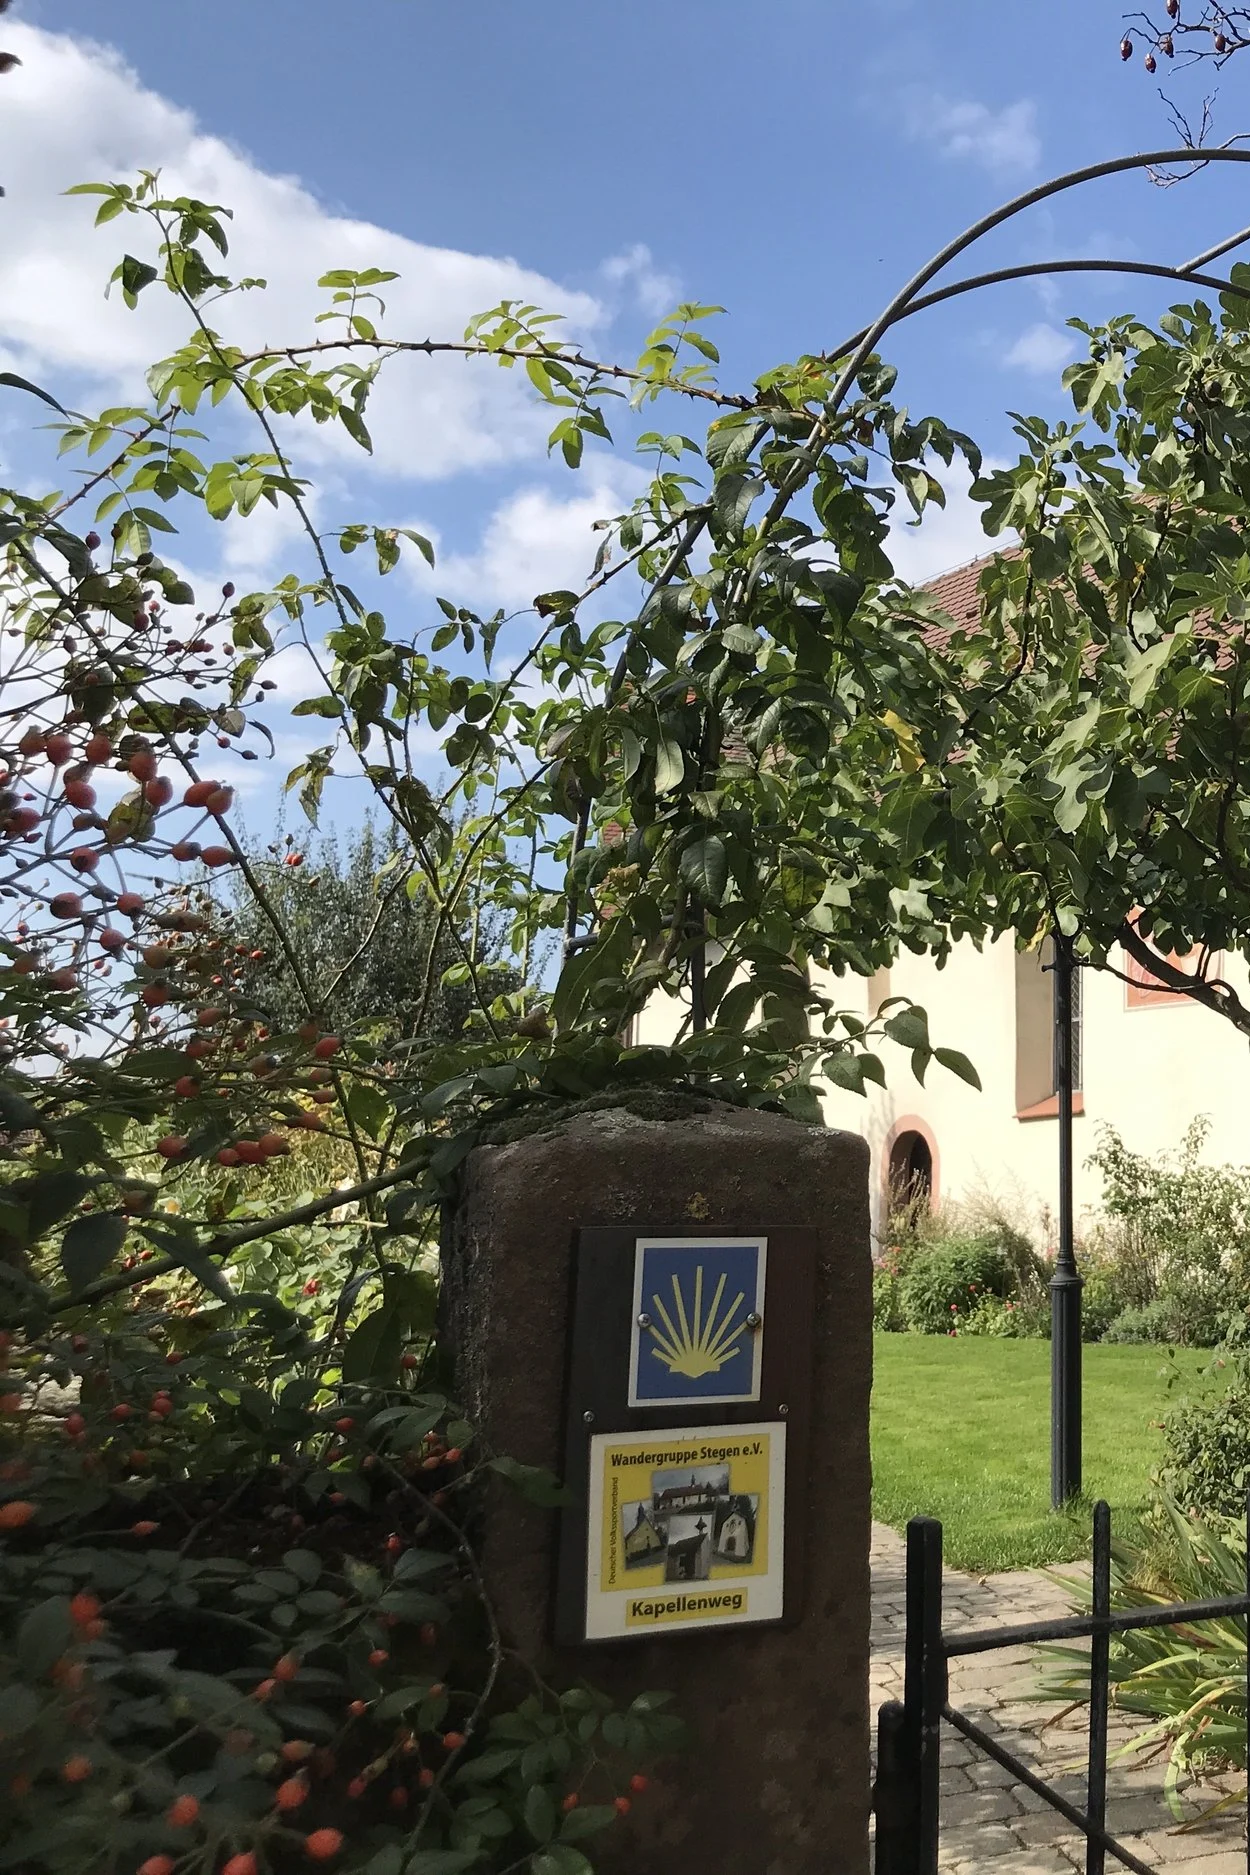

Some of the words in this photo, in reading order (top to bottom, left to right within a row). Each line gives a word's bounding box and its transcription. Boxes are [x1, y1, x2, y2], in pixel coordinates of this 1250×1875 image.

[611, 1450, 698, 1467] Wandergruppe
[700, 1446, 740, 1460] Stegen
[742, 1441, 763, 1456] e.V.
[632, 1594, 742, 1618] Kapellenweg
